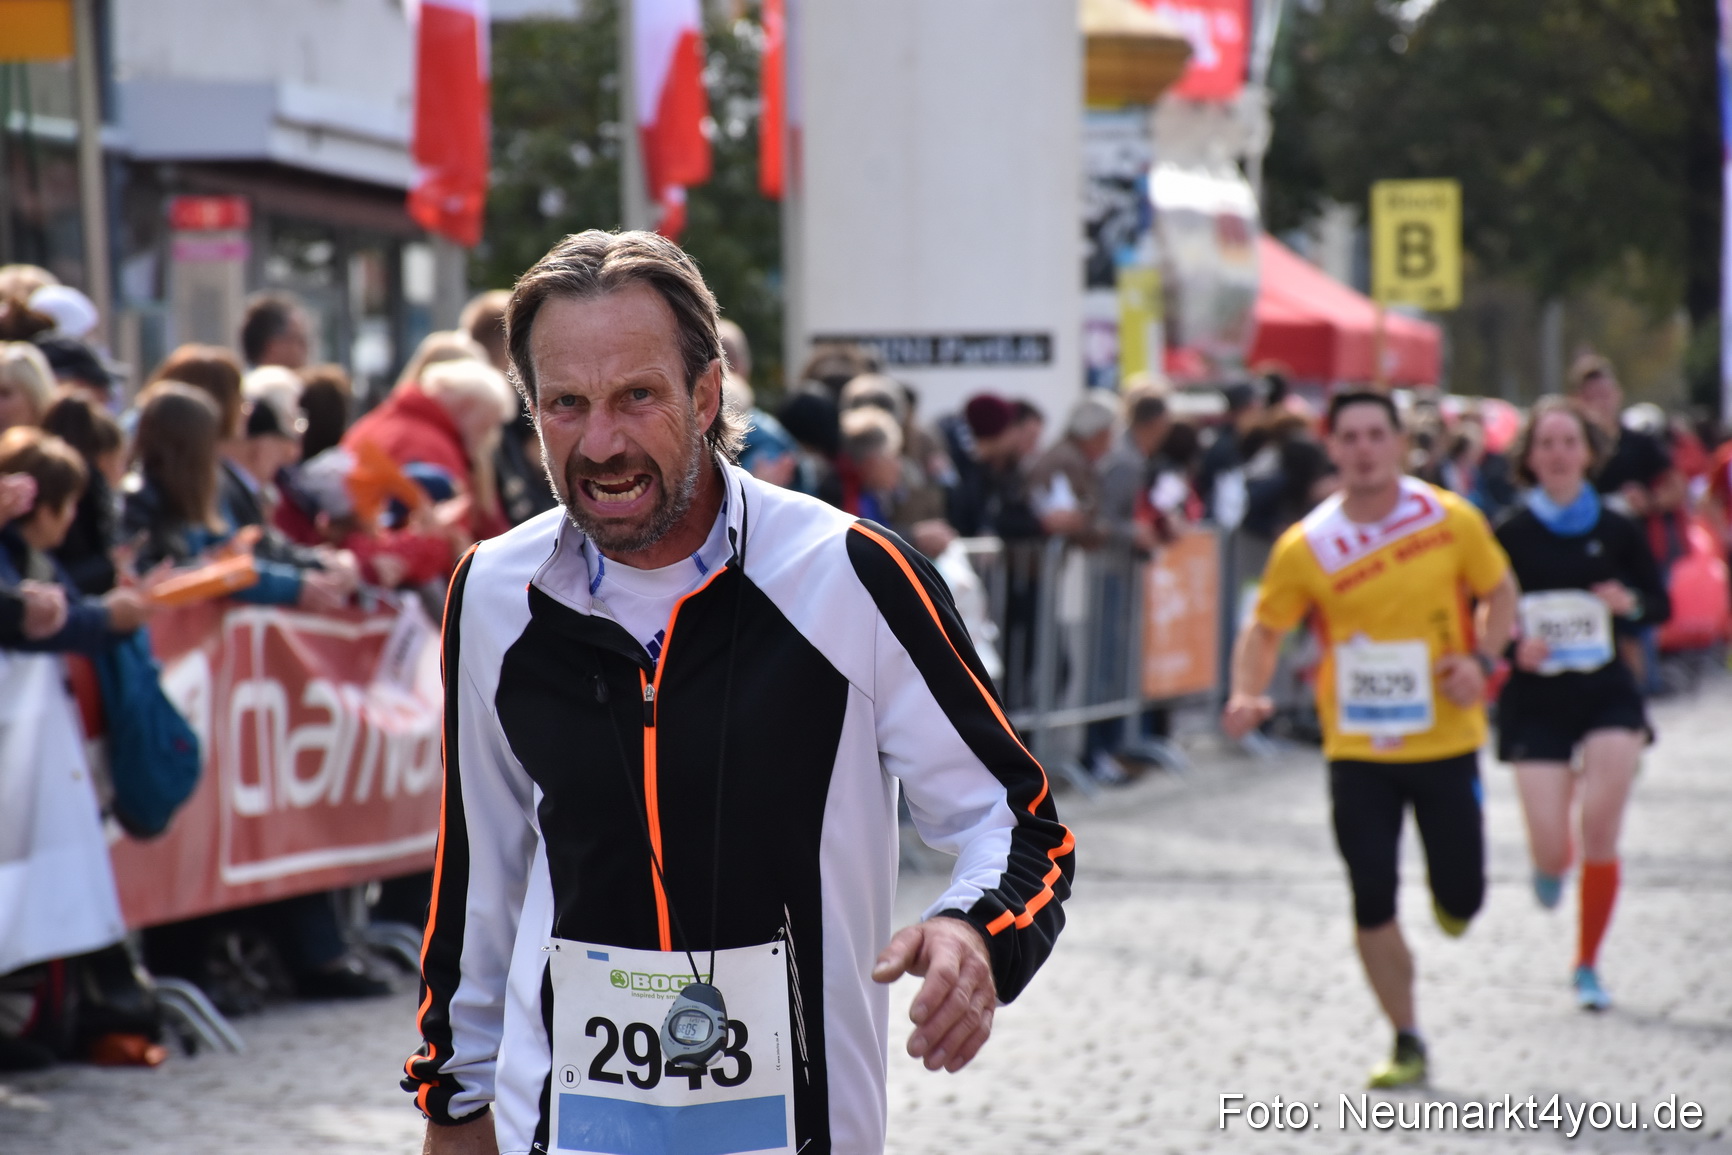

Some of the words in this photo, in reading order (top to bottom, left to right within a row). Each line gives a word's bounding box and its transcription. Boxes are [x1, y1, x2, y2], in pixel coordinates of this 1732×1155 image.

[1396, 221, 1437, 279] B
[631, 991, 655, 999] inspired
[566, 1070, 574, 1083] D
